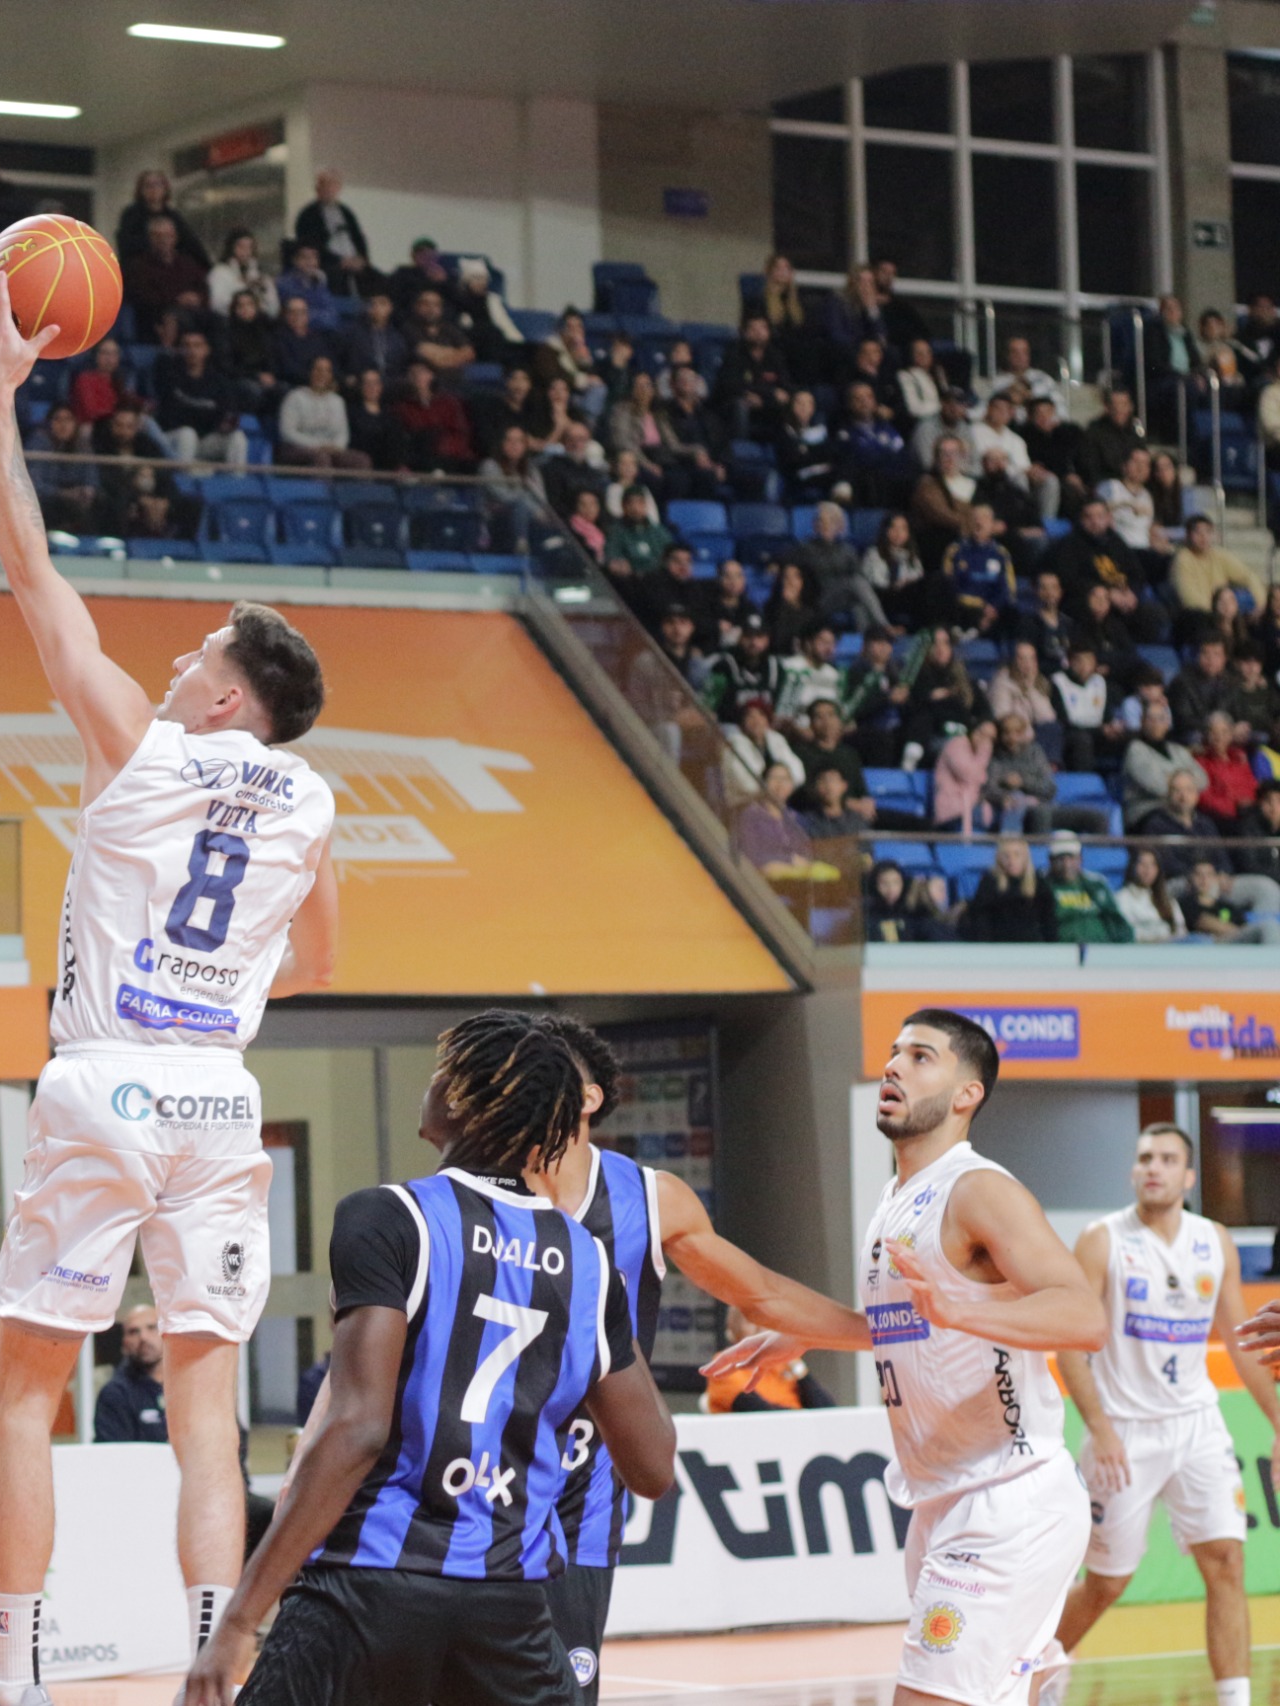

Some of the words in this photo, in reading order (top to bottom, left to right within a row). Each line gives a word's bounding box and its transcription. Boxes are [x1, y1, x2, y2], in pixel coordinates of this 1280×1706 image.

[164, 829, 250, 953] 8
[157, 953, 239, 987] raposo
[120, 991, 172, 1018] FARMA
[1000, 1015, 1075, 1041] CONDE
[156, 1094, 254, 1120] COTREL
[460, 1292, 549, 1424] 7
[1162, 1353, 1179, 1385] 4
